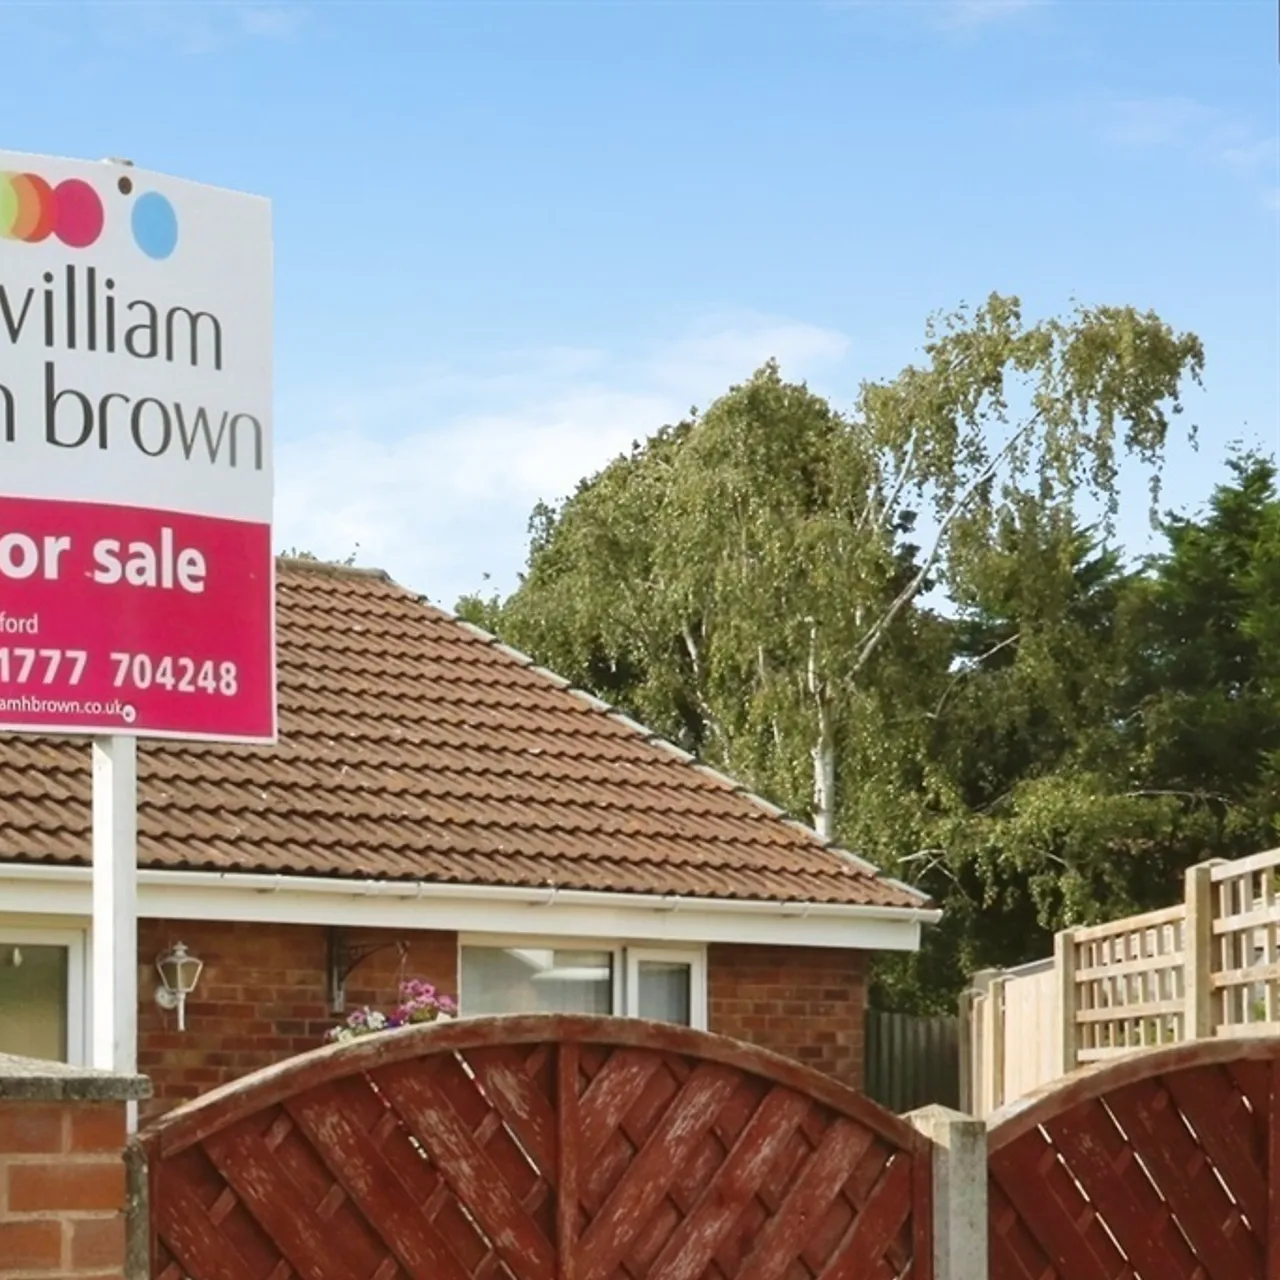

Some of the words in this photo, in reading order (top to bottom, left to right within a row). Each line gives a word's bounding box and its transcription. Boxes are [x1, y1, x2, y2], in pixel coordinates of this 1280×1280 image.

[44, 361, 263, 470] brown
[93, 527, 207, 593] sale
[110, 653, 238, 697] 704248
